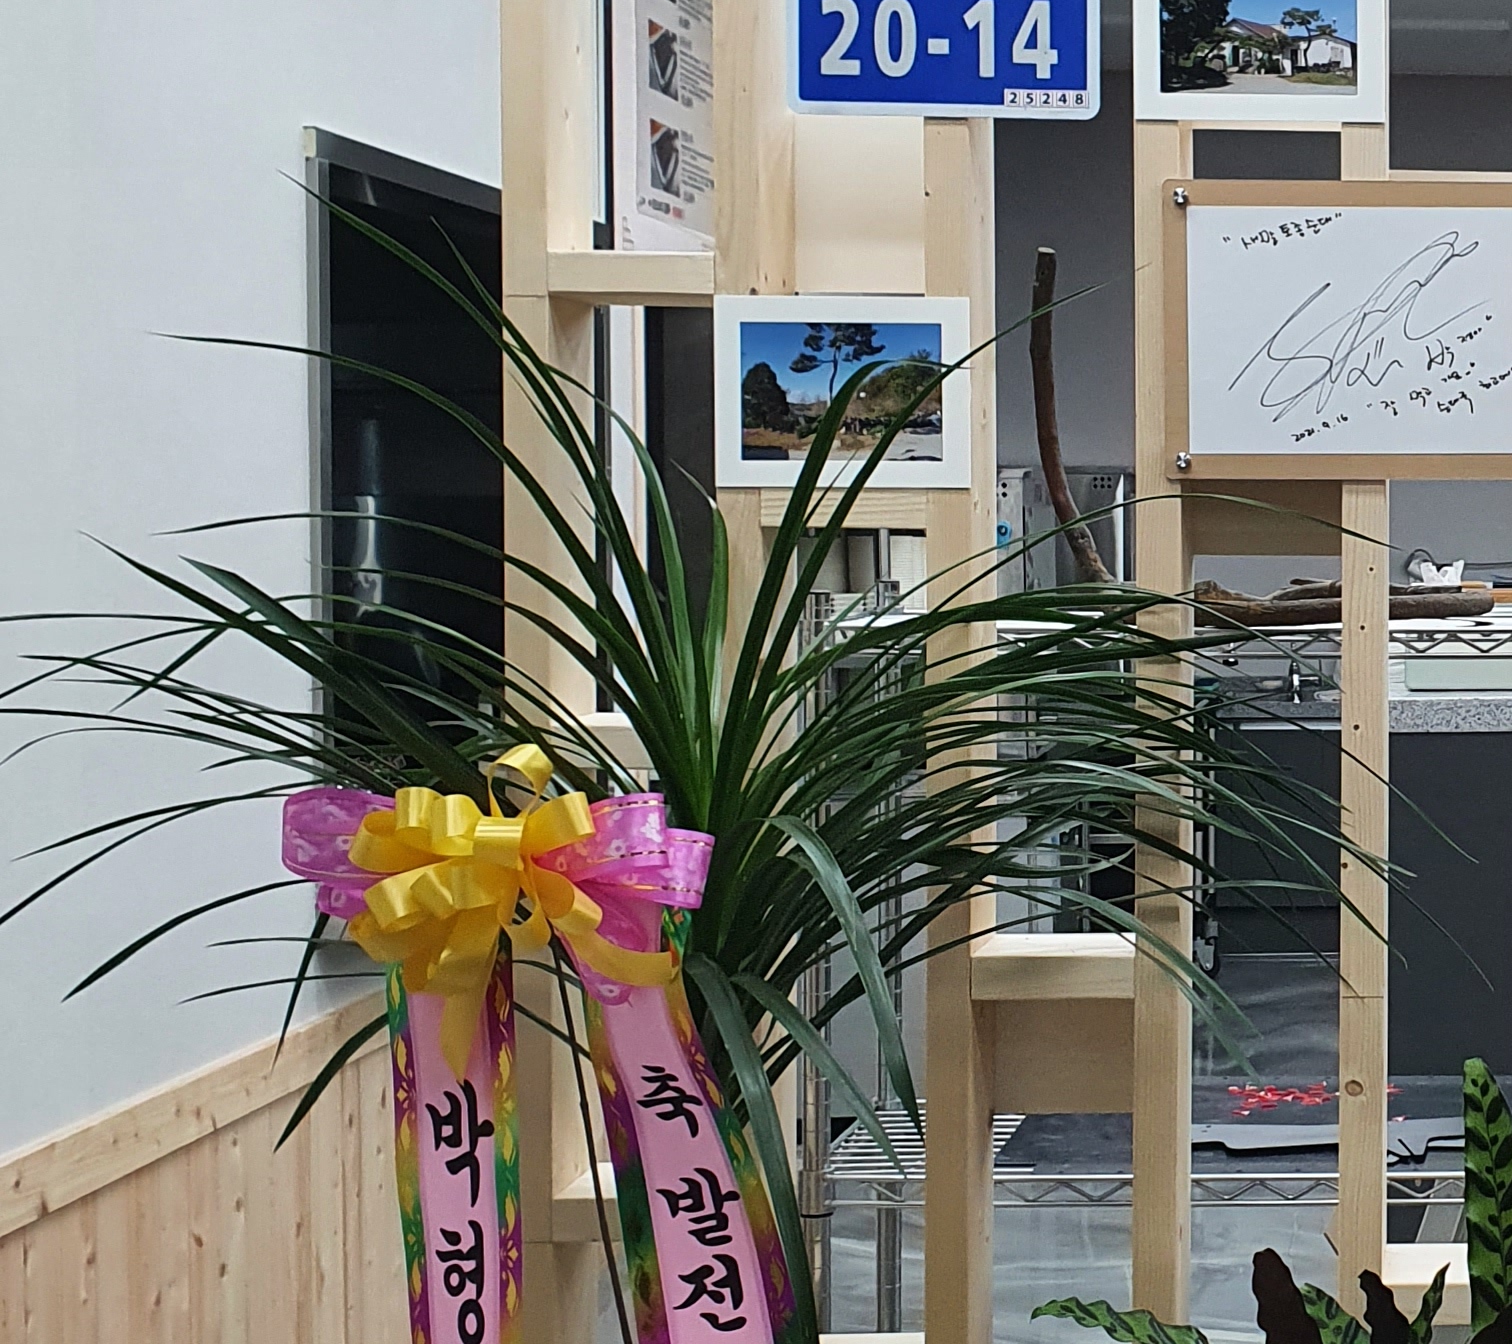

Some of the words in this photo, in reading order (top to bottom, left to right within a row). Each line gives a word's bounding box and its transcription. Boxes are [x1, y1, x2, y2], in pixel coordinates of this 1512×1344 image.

[1008, 91, 1086, 106] 25248
[636, 1064, 704, 1138] 축
[655, 1167, 747, 1333] 발전
